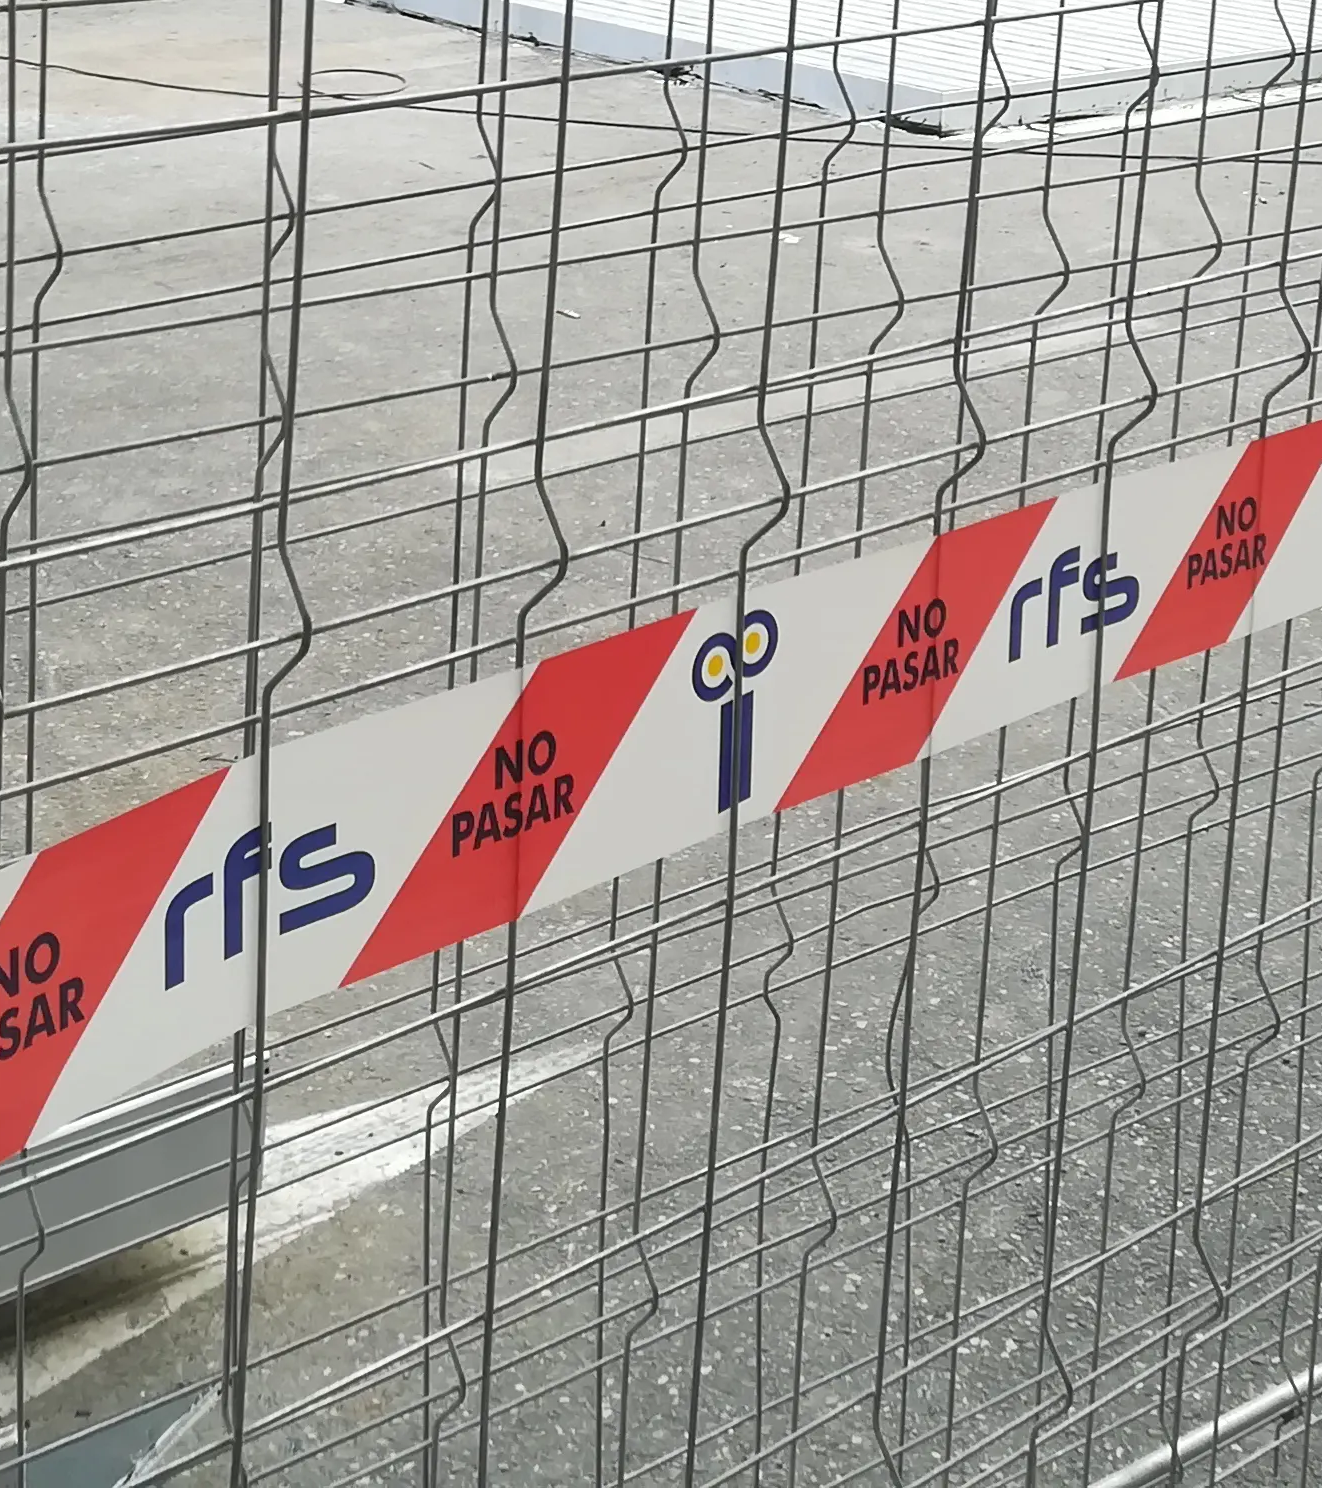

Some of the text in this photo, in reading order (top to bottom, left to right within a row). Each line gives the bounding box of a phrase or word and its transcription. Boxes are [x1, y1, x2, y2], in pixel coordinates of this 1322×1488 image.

[1216, 496, 1257, 540] NO
[1187, 533, 1268, 591] PASAR
[897, 598, 947, 648] NO
[1008, 545, 1141, 663] rfs
[862, 638, 959, 705] PASAR
[494, 730, 556, 790] NO
[452, 773, 575, 858] PASAR
[165, 821, 376, 990] rfs
